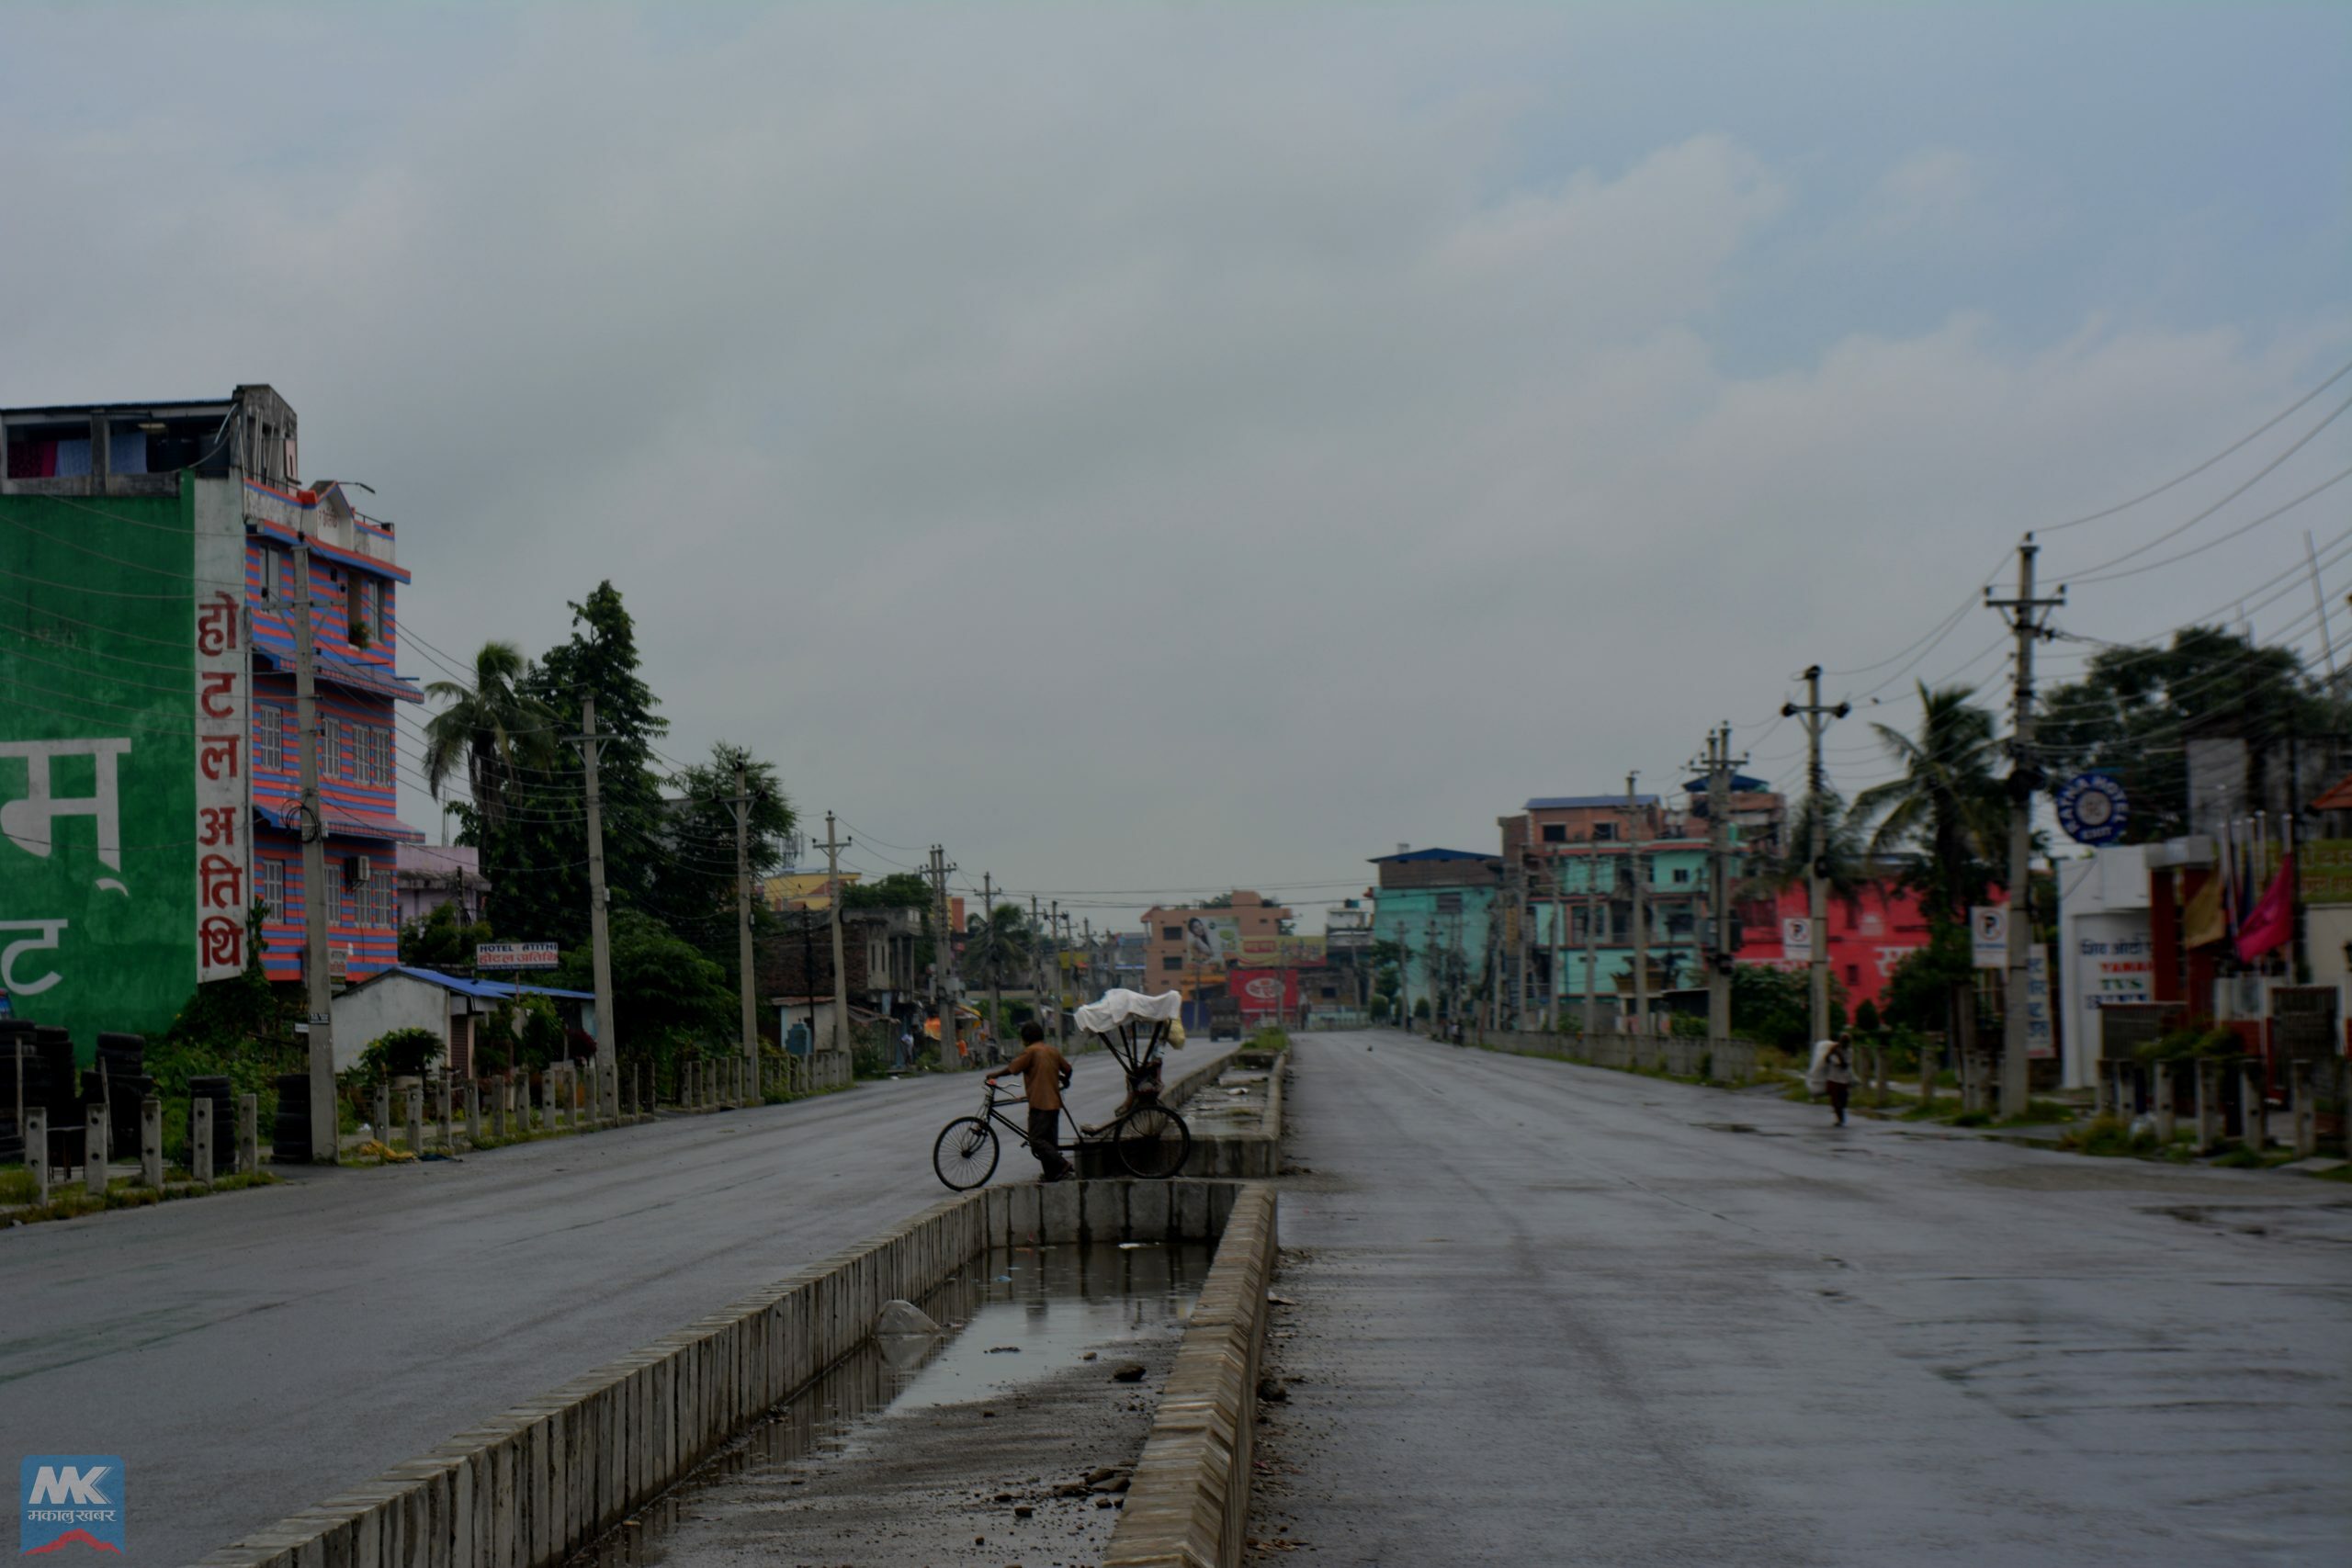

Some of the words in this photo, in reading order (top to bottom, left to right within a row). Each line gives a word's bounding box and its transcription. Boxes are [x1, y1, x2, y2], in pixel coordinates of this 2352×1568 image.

[197, 591, 241, 781] होटल
[198, 806, 243, 968] अतिथि
[480, 943, 514, 953] HOTEL
[479, 952, 514, 964] होटल
[2099, 977, 2143, 990] TVS
